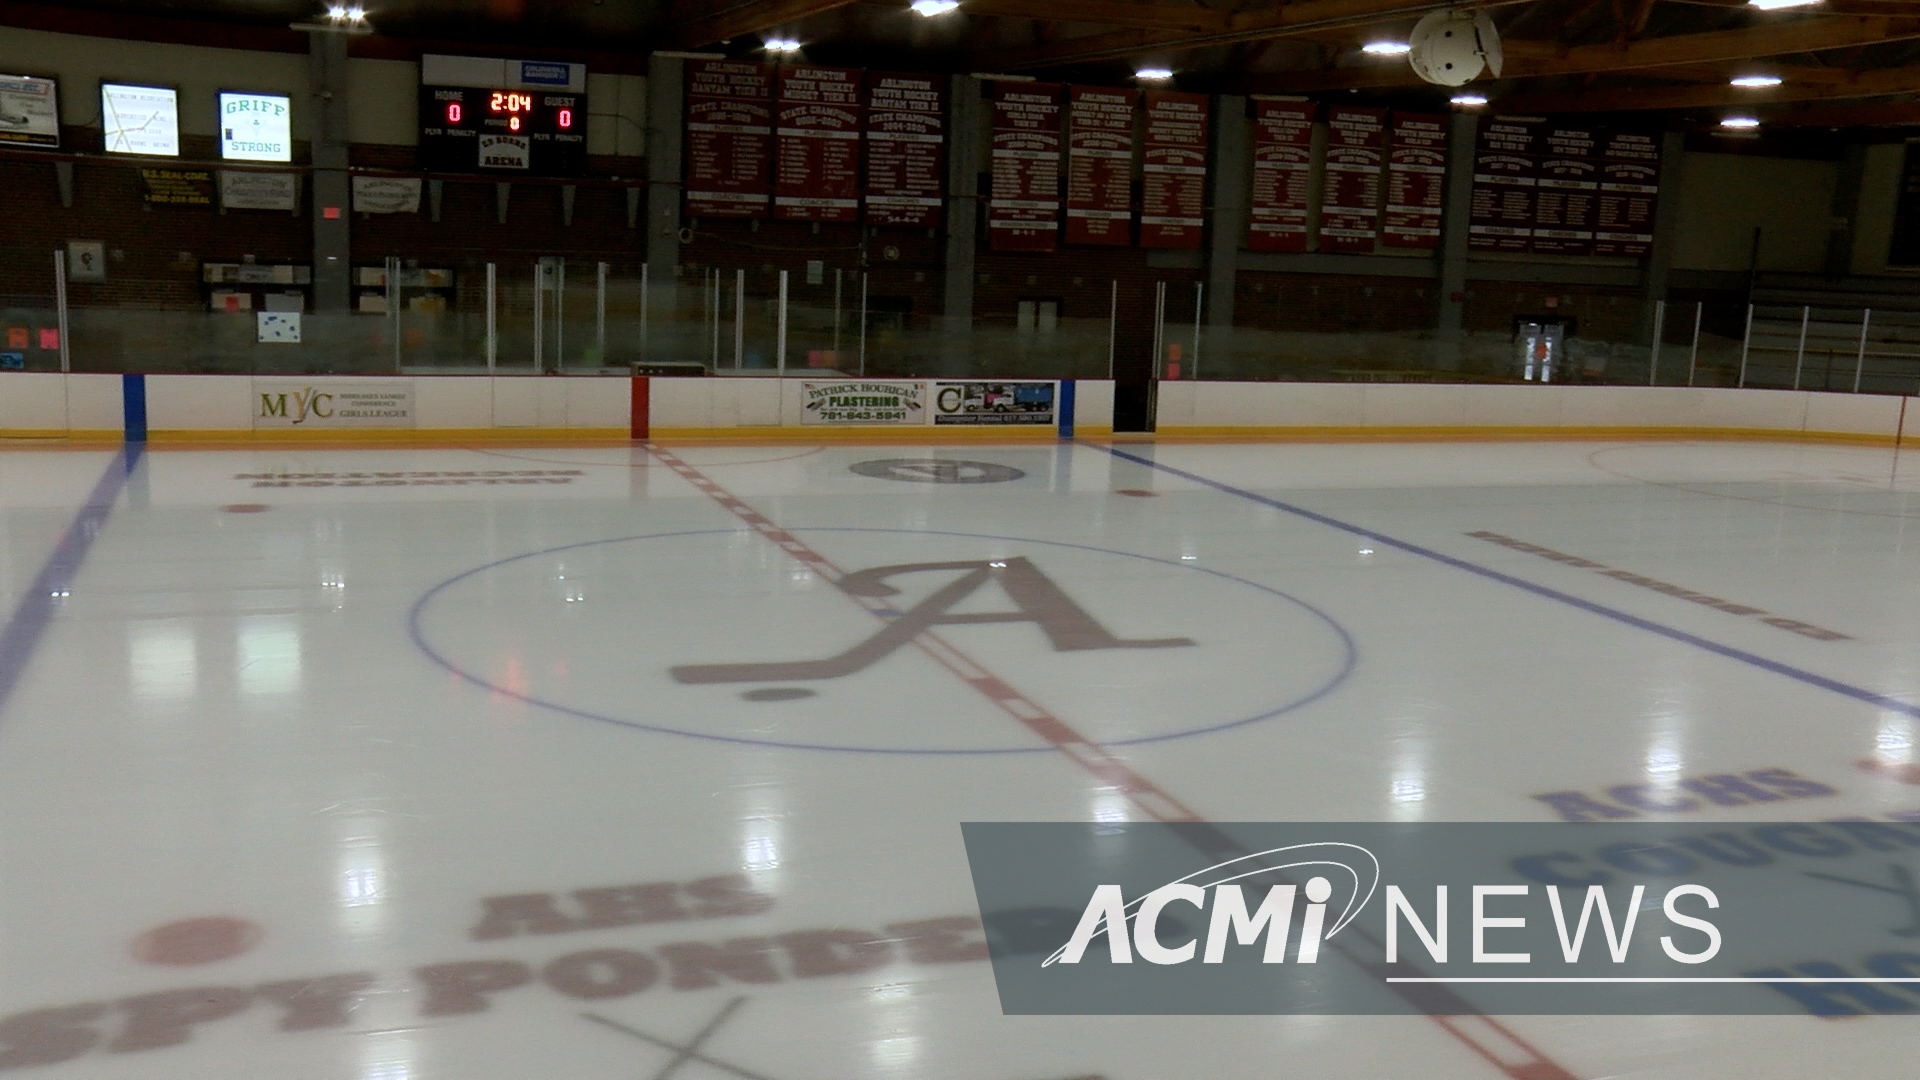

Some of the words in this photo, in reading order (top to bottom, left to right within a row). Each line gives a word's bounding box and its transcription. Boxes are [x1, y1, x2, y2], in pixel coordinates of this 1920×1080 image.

[794, 70, 846, 81] ARLINGTON
[784, 80, 815, 90] YOUTH
[819, 82, 855, 92] HOCKEY
[880, 79, 931, 90] ARLINGTON
[435, 90, 463, 101] HOME
[872, 89, 902, 99] YOUTH
[903, 91, 939, 101] HOCKEY
[226, 99, 285, 116] GRIFF
[491, 93, 531, 112] 2:04
[544, 96, 576, 107] GUEST
[449, 104, 461, 122] 0
[559, 110, 571, 128] 0
[447, 128, 476, 137] PENALTY
[554, 133, 583, 142] PENALTY
[231, 141, 281, 153] STRONG
[484, 156, 523, 167] ARENA
[808, 384, 858, 399] PATRICK
[829, 396, 899, 407] PLASTERING
[340, 410, 369, 418] GIRLS
[370, 410, 408, 418] LEAGUE
[1530, 768, 1840, 823] ACHS
[468, 873, 776, 942] AHS
[0, 970, 377, 1071] SPY
